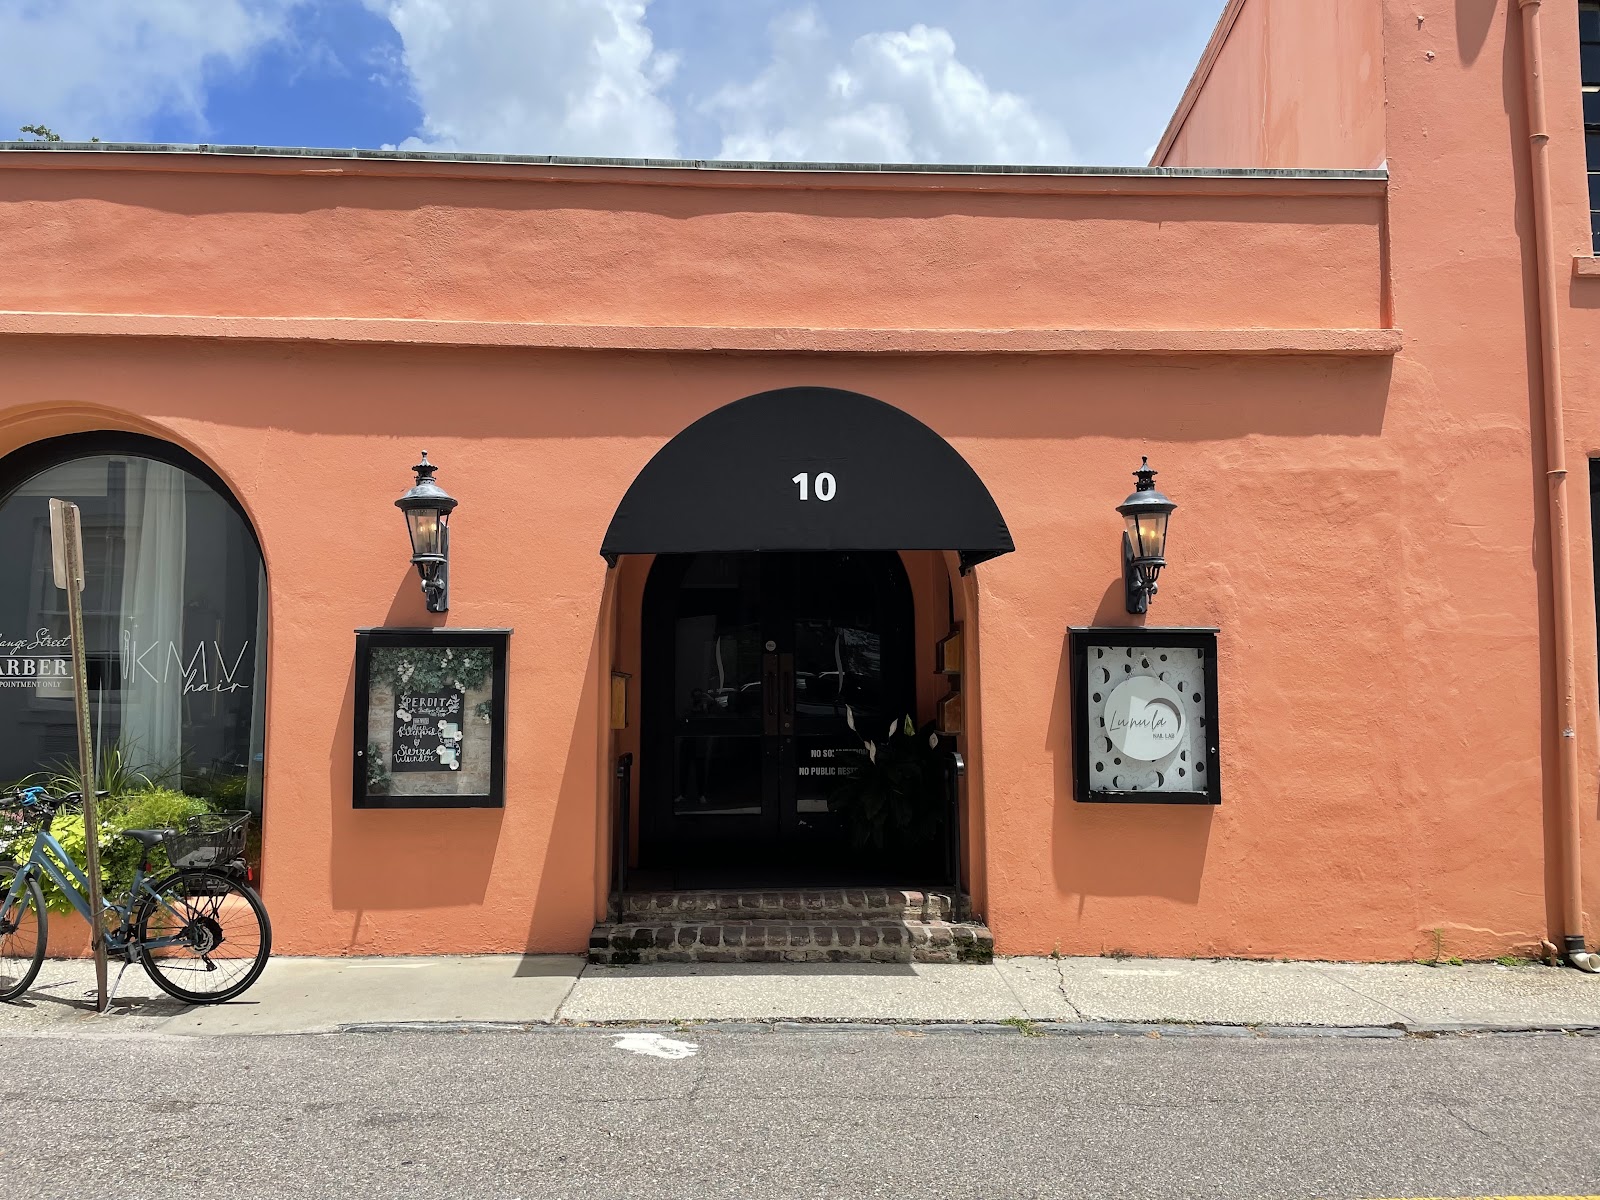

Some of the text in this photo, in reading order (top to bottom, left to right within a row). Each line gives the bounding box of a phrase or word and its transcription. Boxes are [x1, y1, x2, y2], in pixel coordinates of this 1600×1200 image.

[792, 472, 837, 501] 10
[27, 627, 71, 650] Street
[132, 640, 248, 683] KMV
[183, 669, 249, 695] hair
[406, 698, 453, 706] PERDITA
[1110, 709, 1167, 731] Lunula
[397, 744, 437, 756] Sierra
[810, 749, 822, 758] NO
[798, 767, 810, 776] NO
[810, 767, 836, 776] PUBLIC
